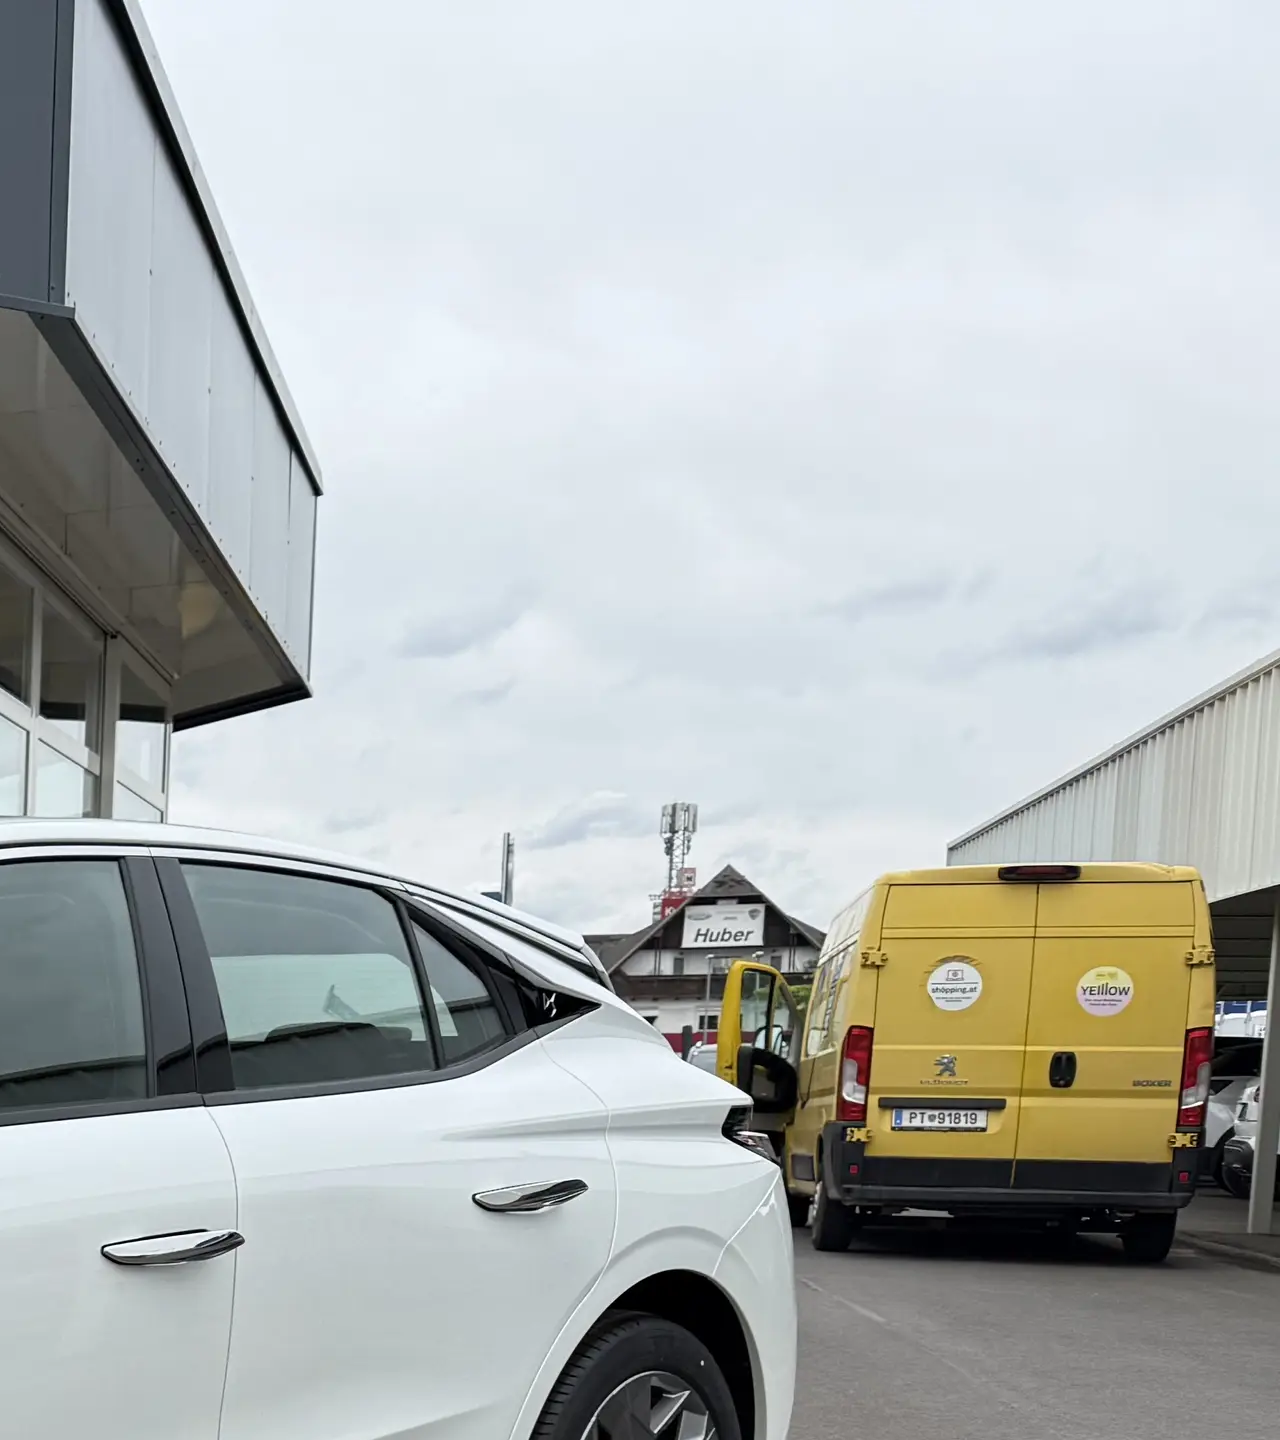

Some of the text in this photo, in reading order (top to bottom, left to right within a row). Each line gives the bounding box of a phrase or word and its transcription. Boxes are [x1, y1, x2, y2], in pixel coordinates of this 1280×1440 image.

[693, 927, 754, 943] Huber
[909, 1112, 978, 1125] PT 91819
